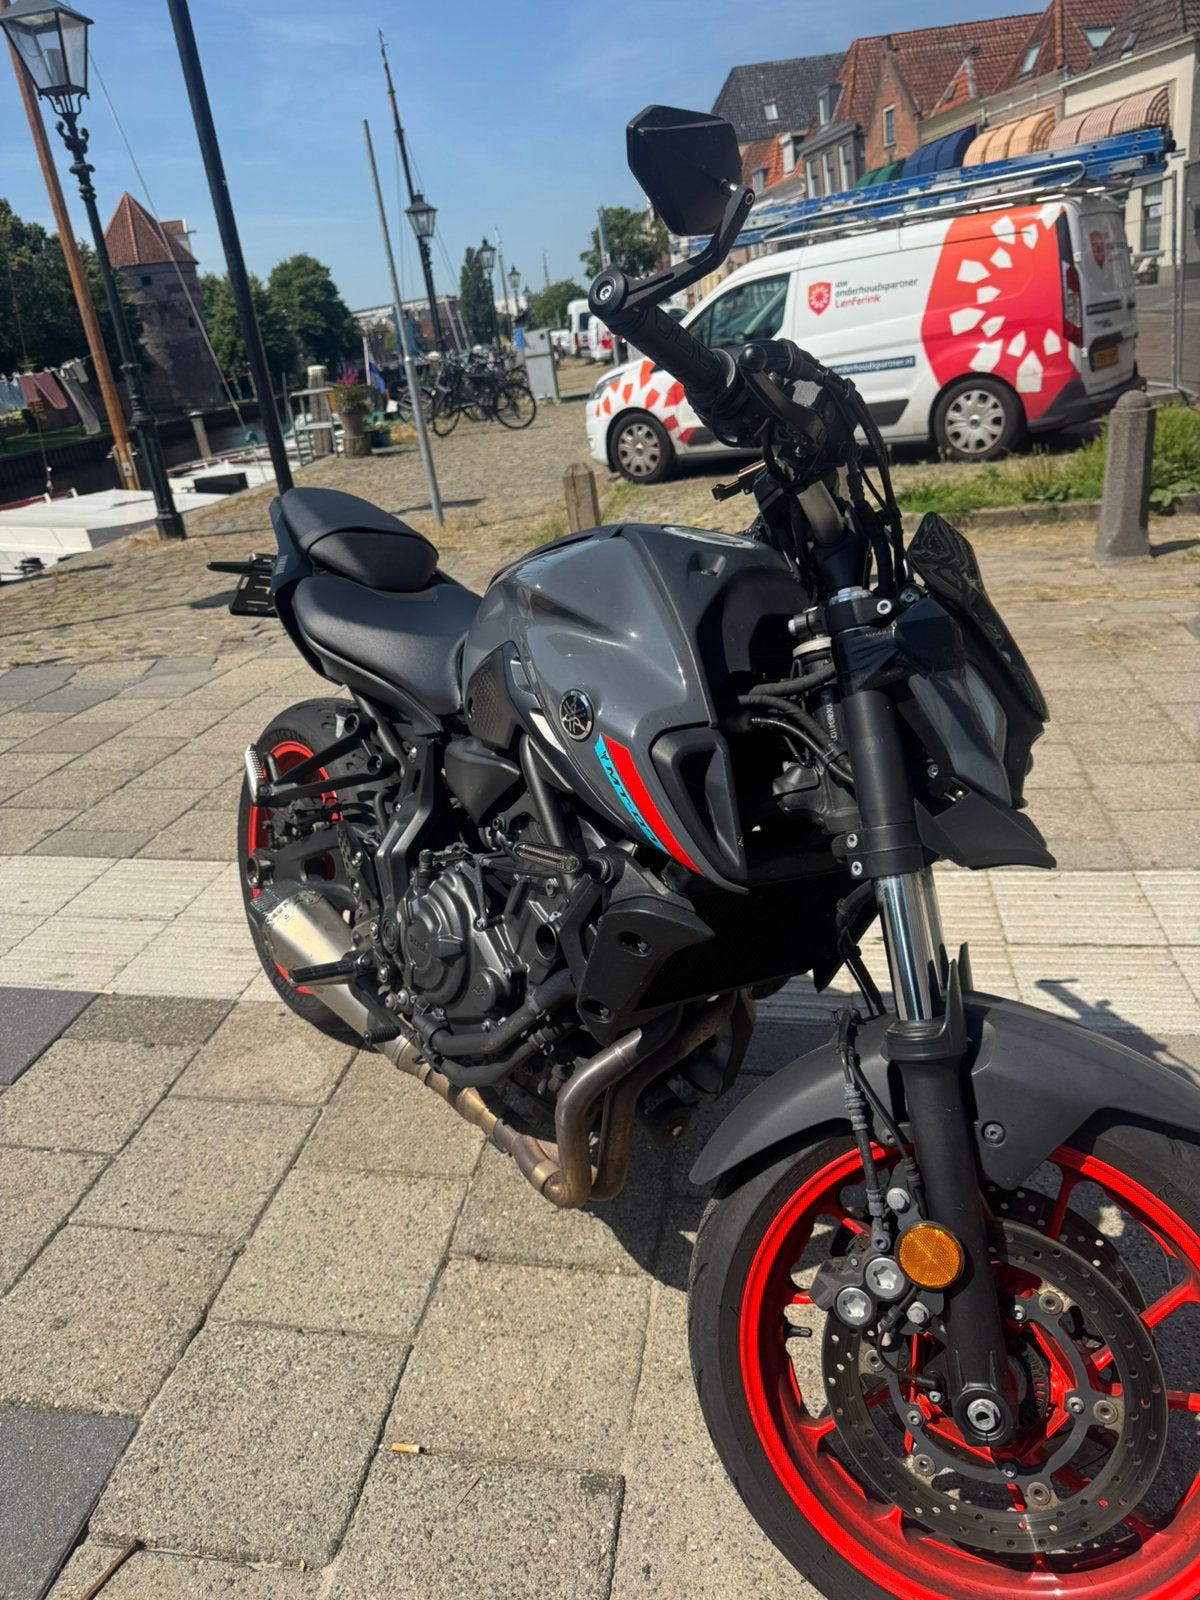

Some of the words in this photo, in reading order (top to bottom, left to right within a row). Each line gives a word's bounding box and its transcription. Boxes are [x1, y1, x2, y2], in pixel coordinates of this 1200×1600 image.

[835, 279, 918, 297] onderhoudspartner
[835, 295, 880, 308] Lenferink
[605, 765, 659, 843] MT-07
